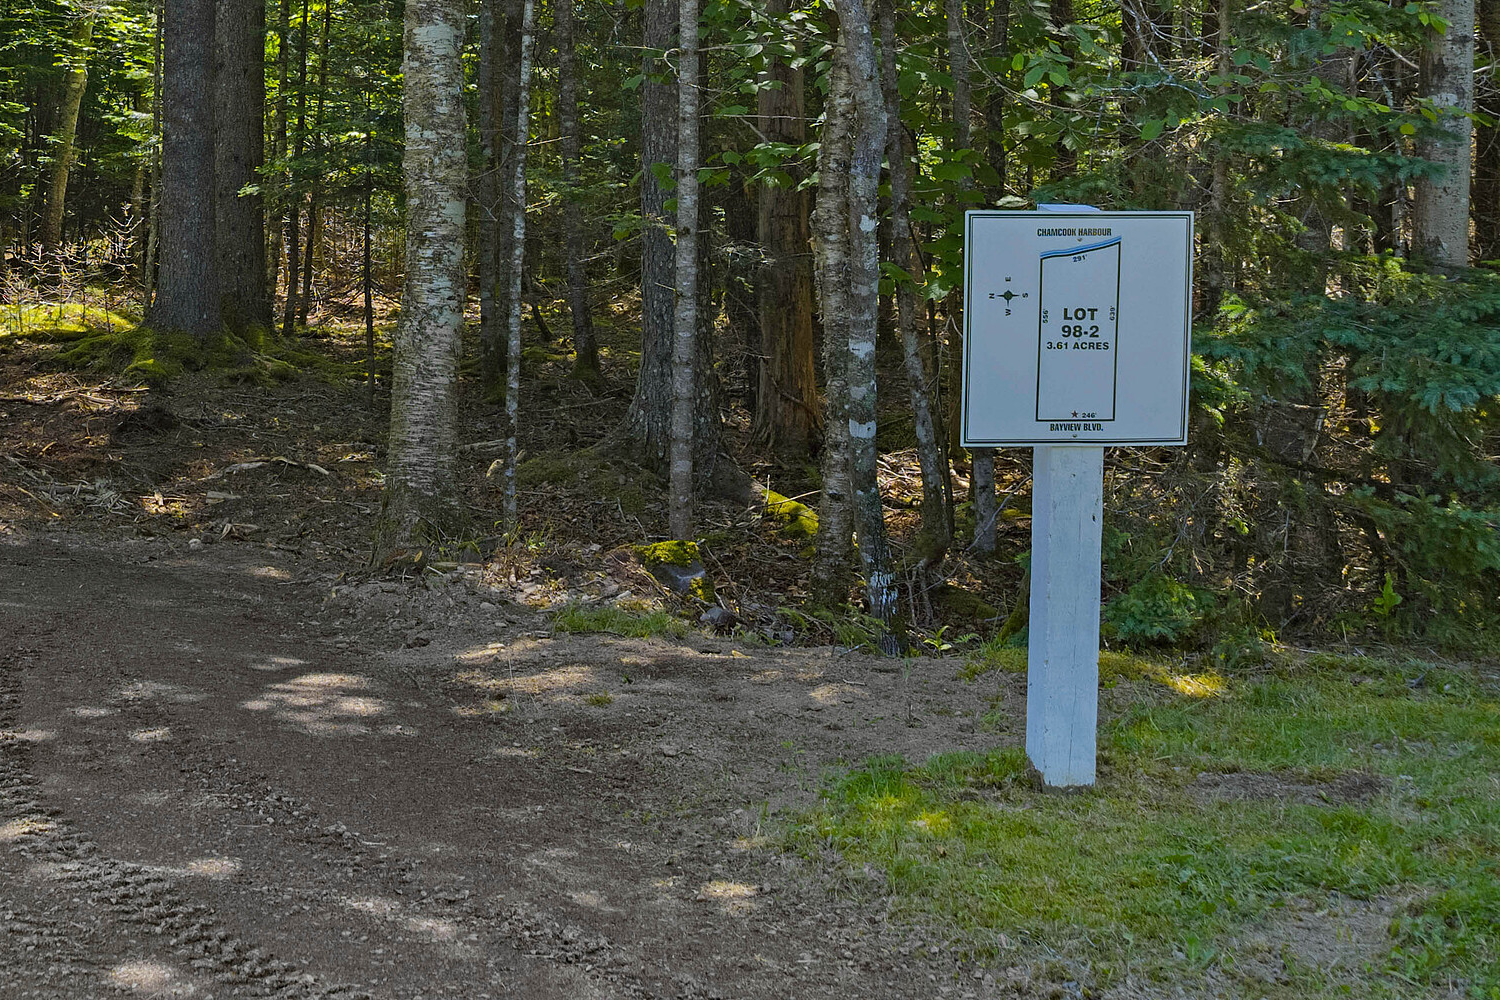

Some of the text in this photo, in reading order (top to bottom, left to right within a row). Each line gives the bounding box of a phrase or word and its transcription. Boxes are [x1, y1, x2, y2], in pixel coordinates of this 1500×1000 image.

[1037, 228, 1112, 236] CHAMCOOK HARBOUR
[1063, 308, 1098, 321] LOT
[1061, 325, 1100, 338] 98-2
[1046, 342, 1110, 350] 3.61 ACRES
[1050, 423, 1104, 431] BAYVIEW BLVD.
